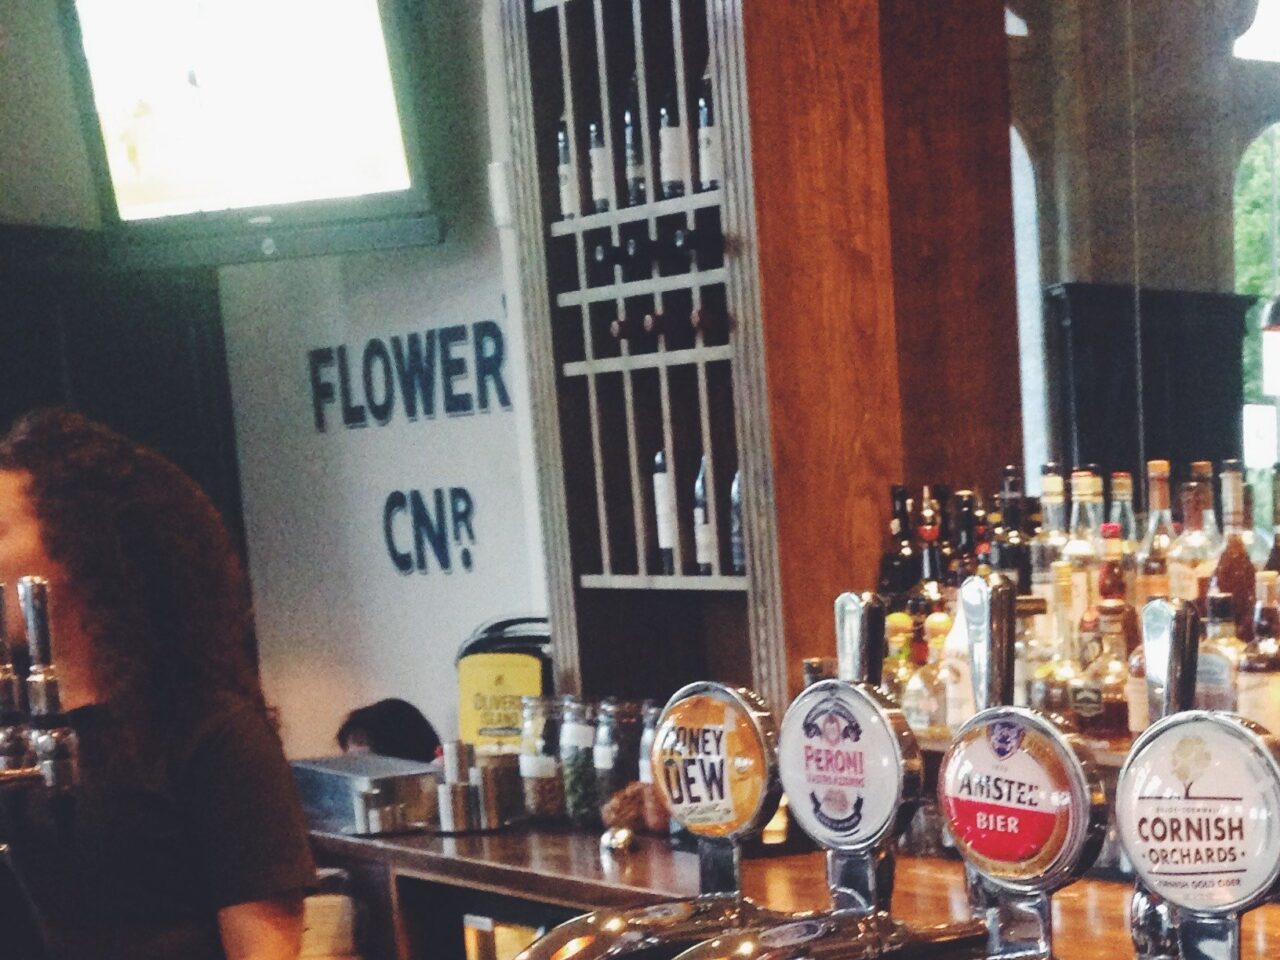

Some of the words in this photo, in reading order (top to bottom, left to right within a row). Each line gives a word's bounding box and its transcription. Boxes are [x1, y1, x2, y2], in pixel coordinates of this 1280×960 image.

[309, 320, 513, 434] FLOWER
[661, 725, 725, 757] ONEY
[664, 758, 725, 804] DEW
[976, 811, 1020, 834] BIER
[1137, 816, 1245, 843] CORNISH
[1148, 846, 1238, 864] ORCHARDS
